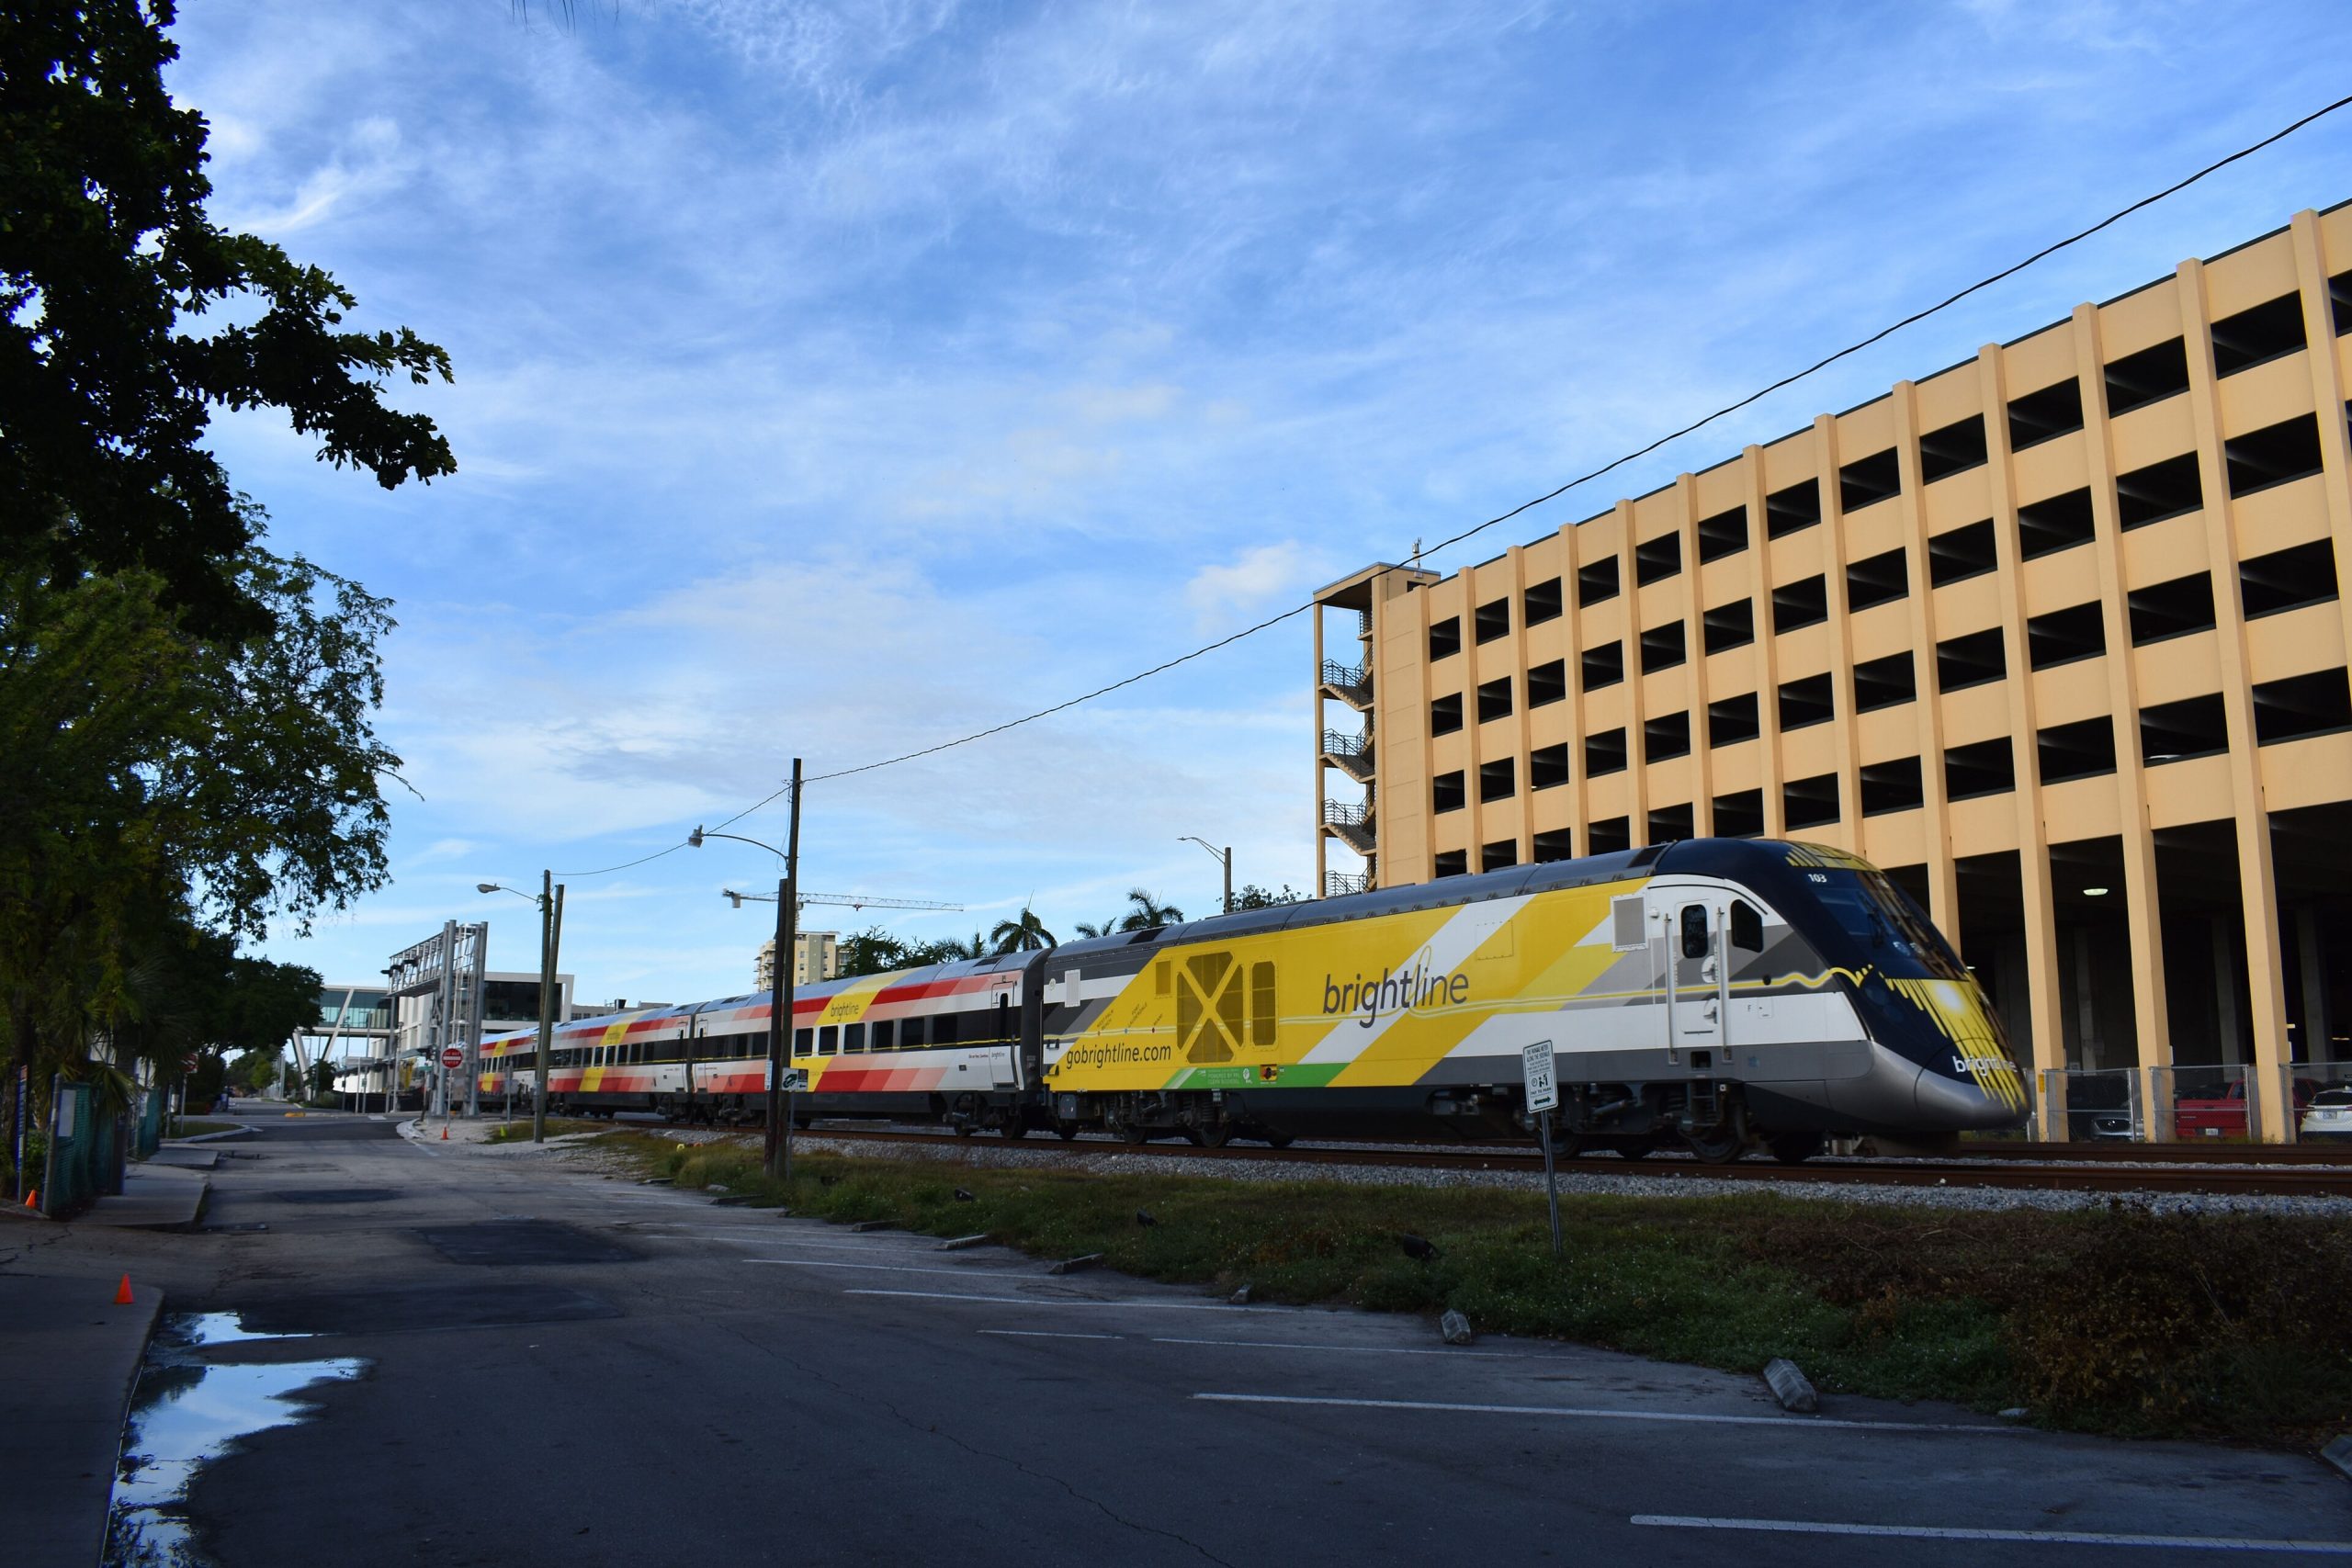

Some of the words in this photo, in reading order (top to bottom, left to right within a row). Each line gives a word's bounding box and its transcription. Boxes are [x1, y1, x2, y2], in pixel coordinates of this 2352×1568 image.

[1808, 874, 1827, 883] 103
[1323, 964, 1469, 1029] brightline
[831, 1002, 859, 1021] brightline
[1066, 1043, 1171, 1069] gobrightline.com
